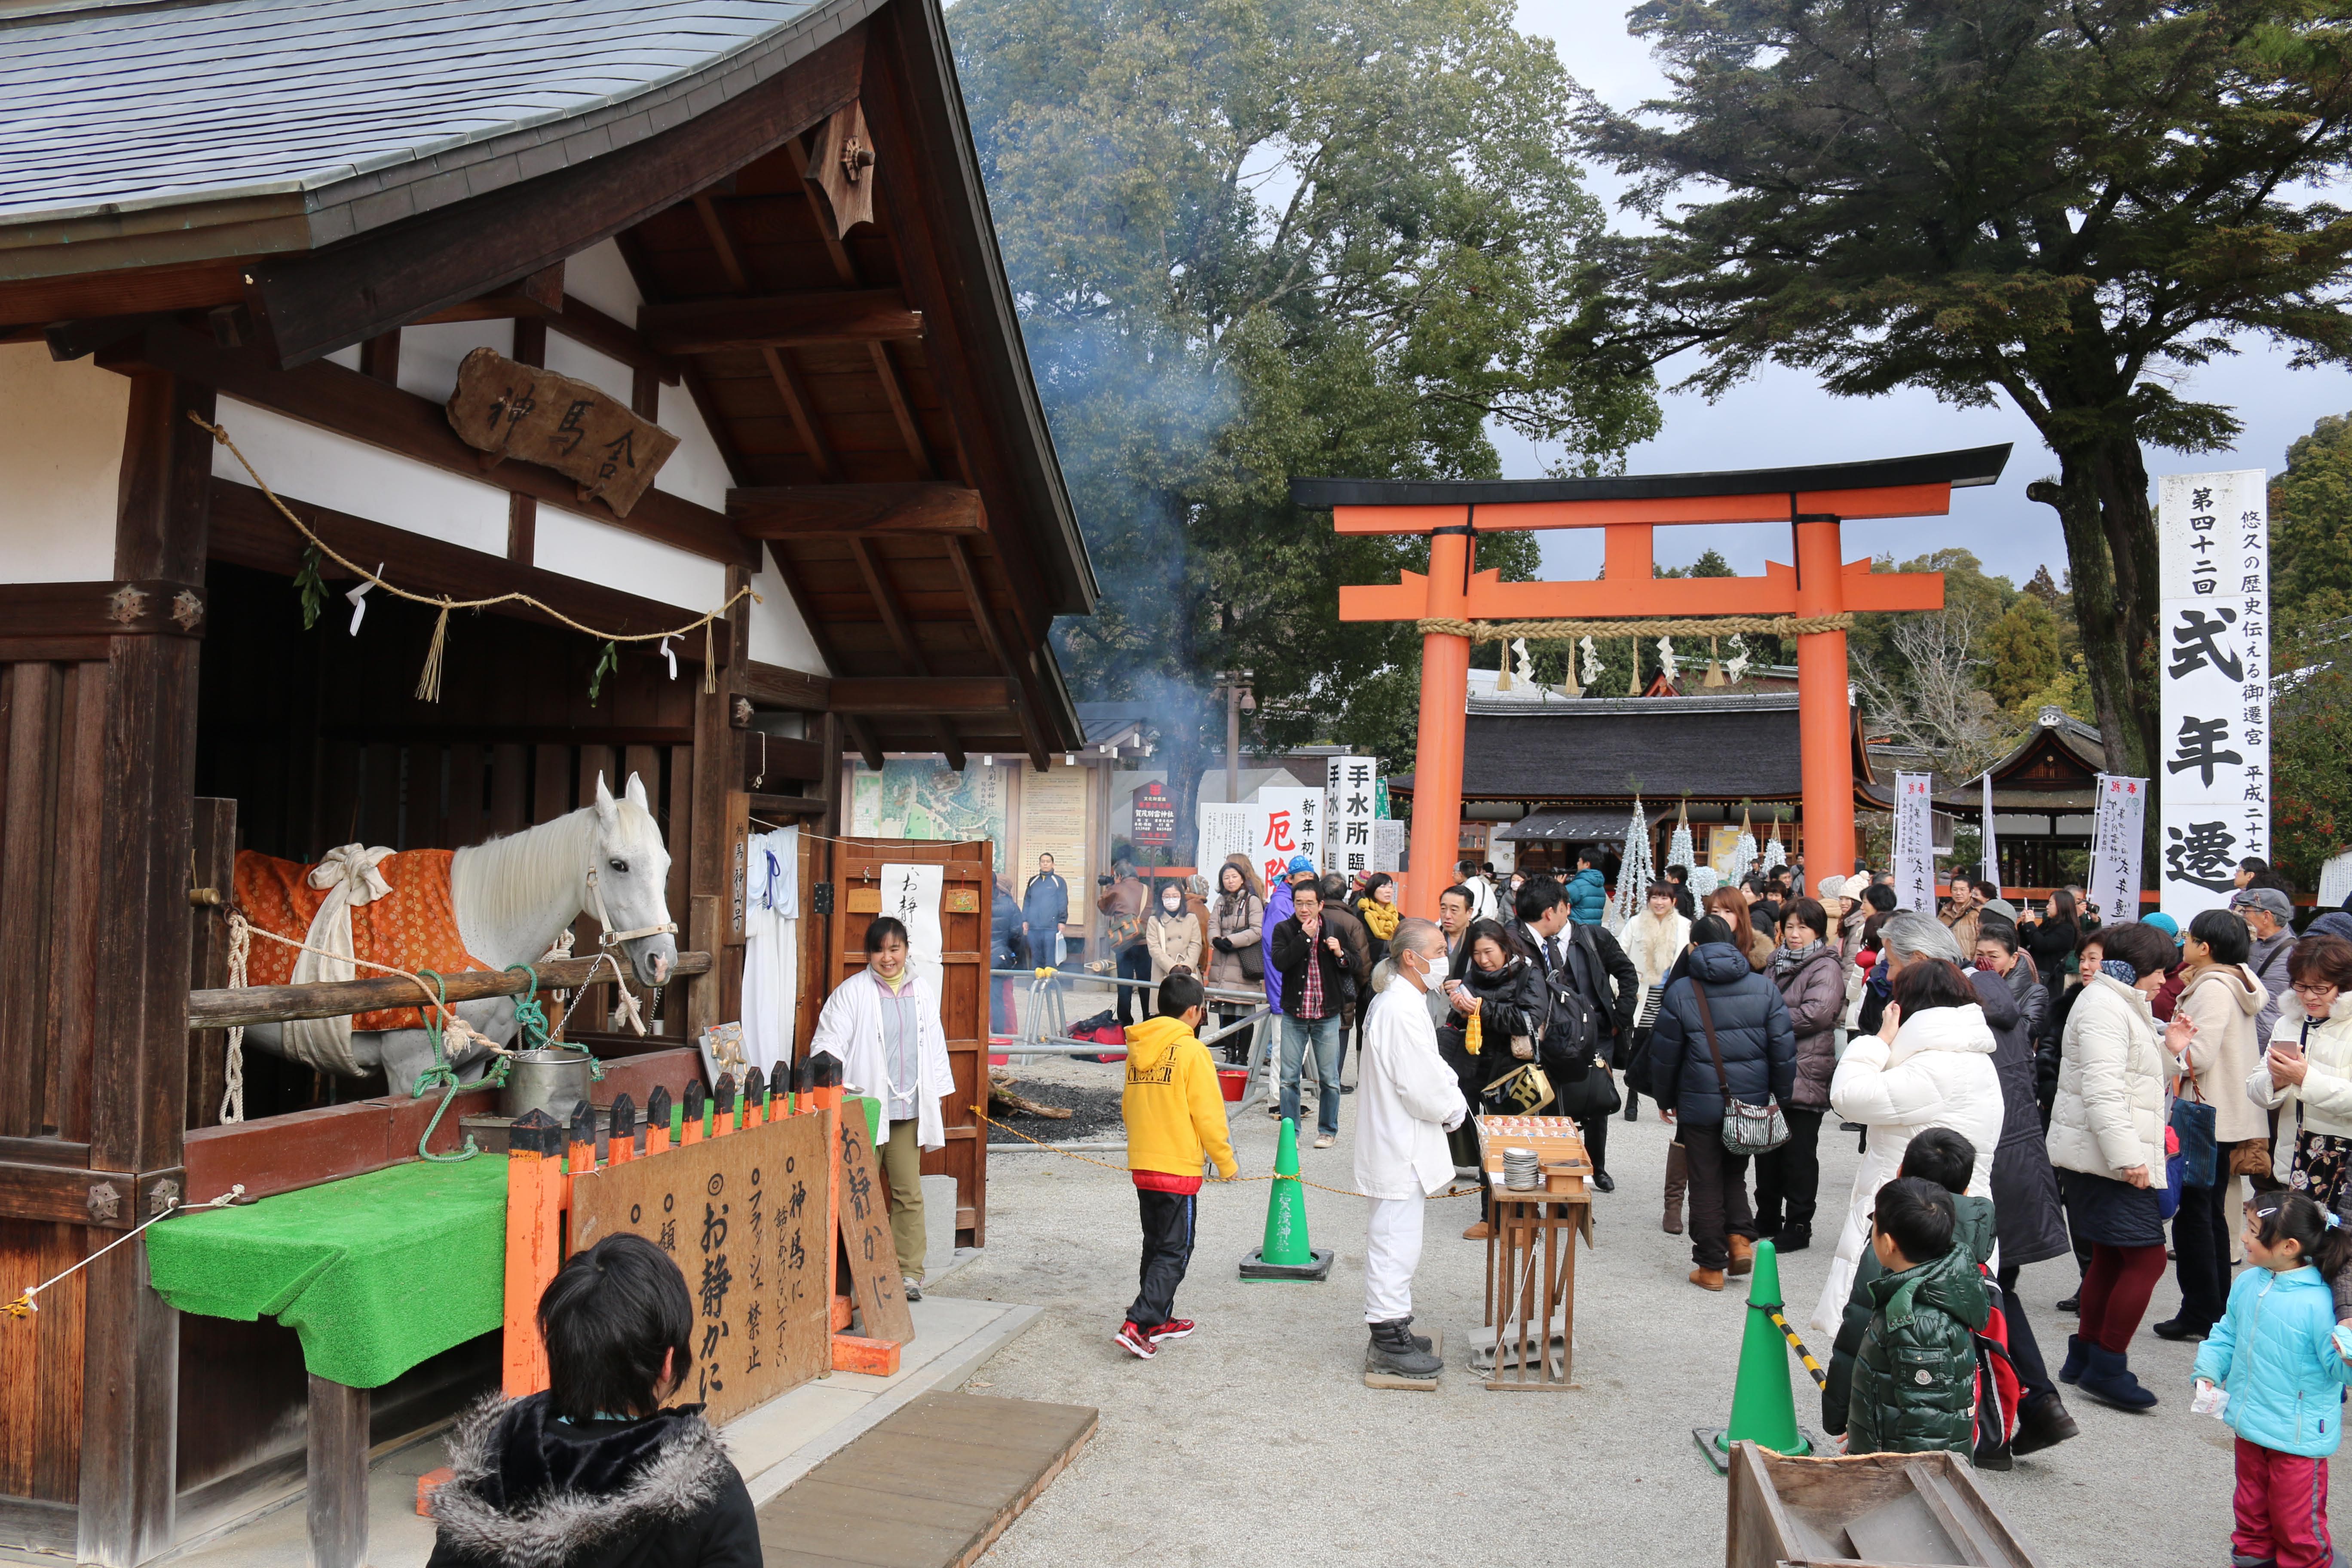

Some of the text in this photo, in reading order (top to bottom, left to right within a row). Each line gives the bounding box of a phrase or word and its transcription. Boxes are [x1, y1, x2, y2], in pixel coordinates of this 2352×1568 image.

[2190, 487, 2217, 596] 第四十二回
[2240, 510, 2265, 857] 悠久の歴史伝える御遷宮 平成二十七
[1301, 798, 1316, 856] 新年初
[698, 1203, 732, 1402] お静かに
[841, 1121, 892, 1310] お静かに
